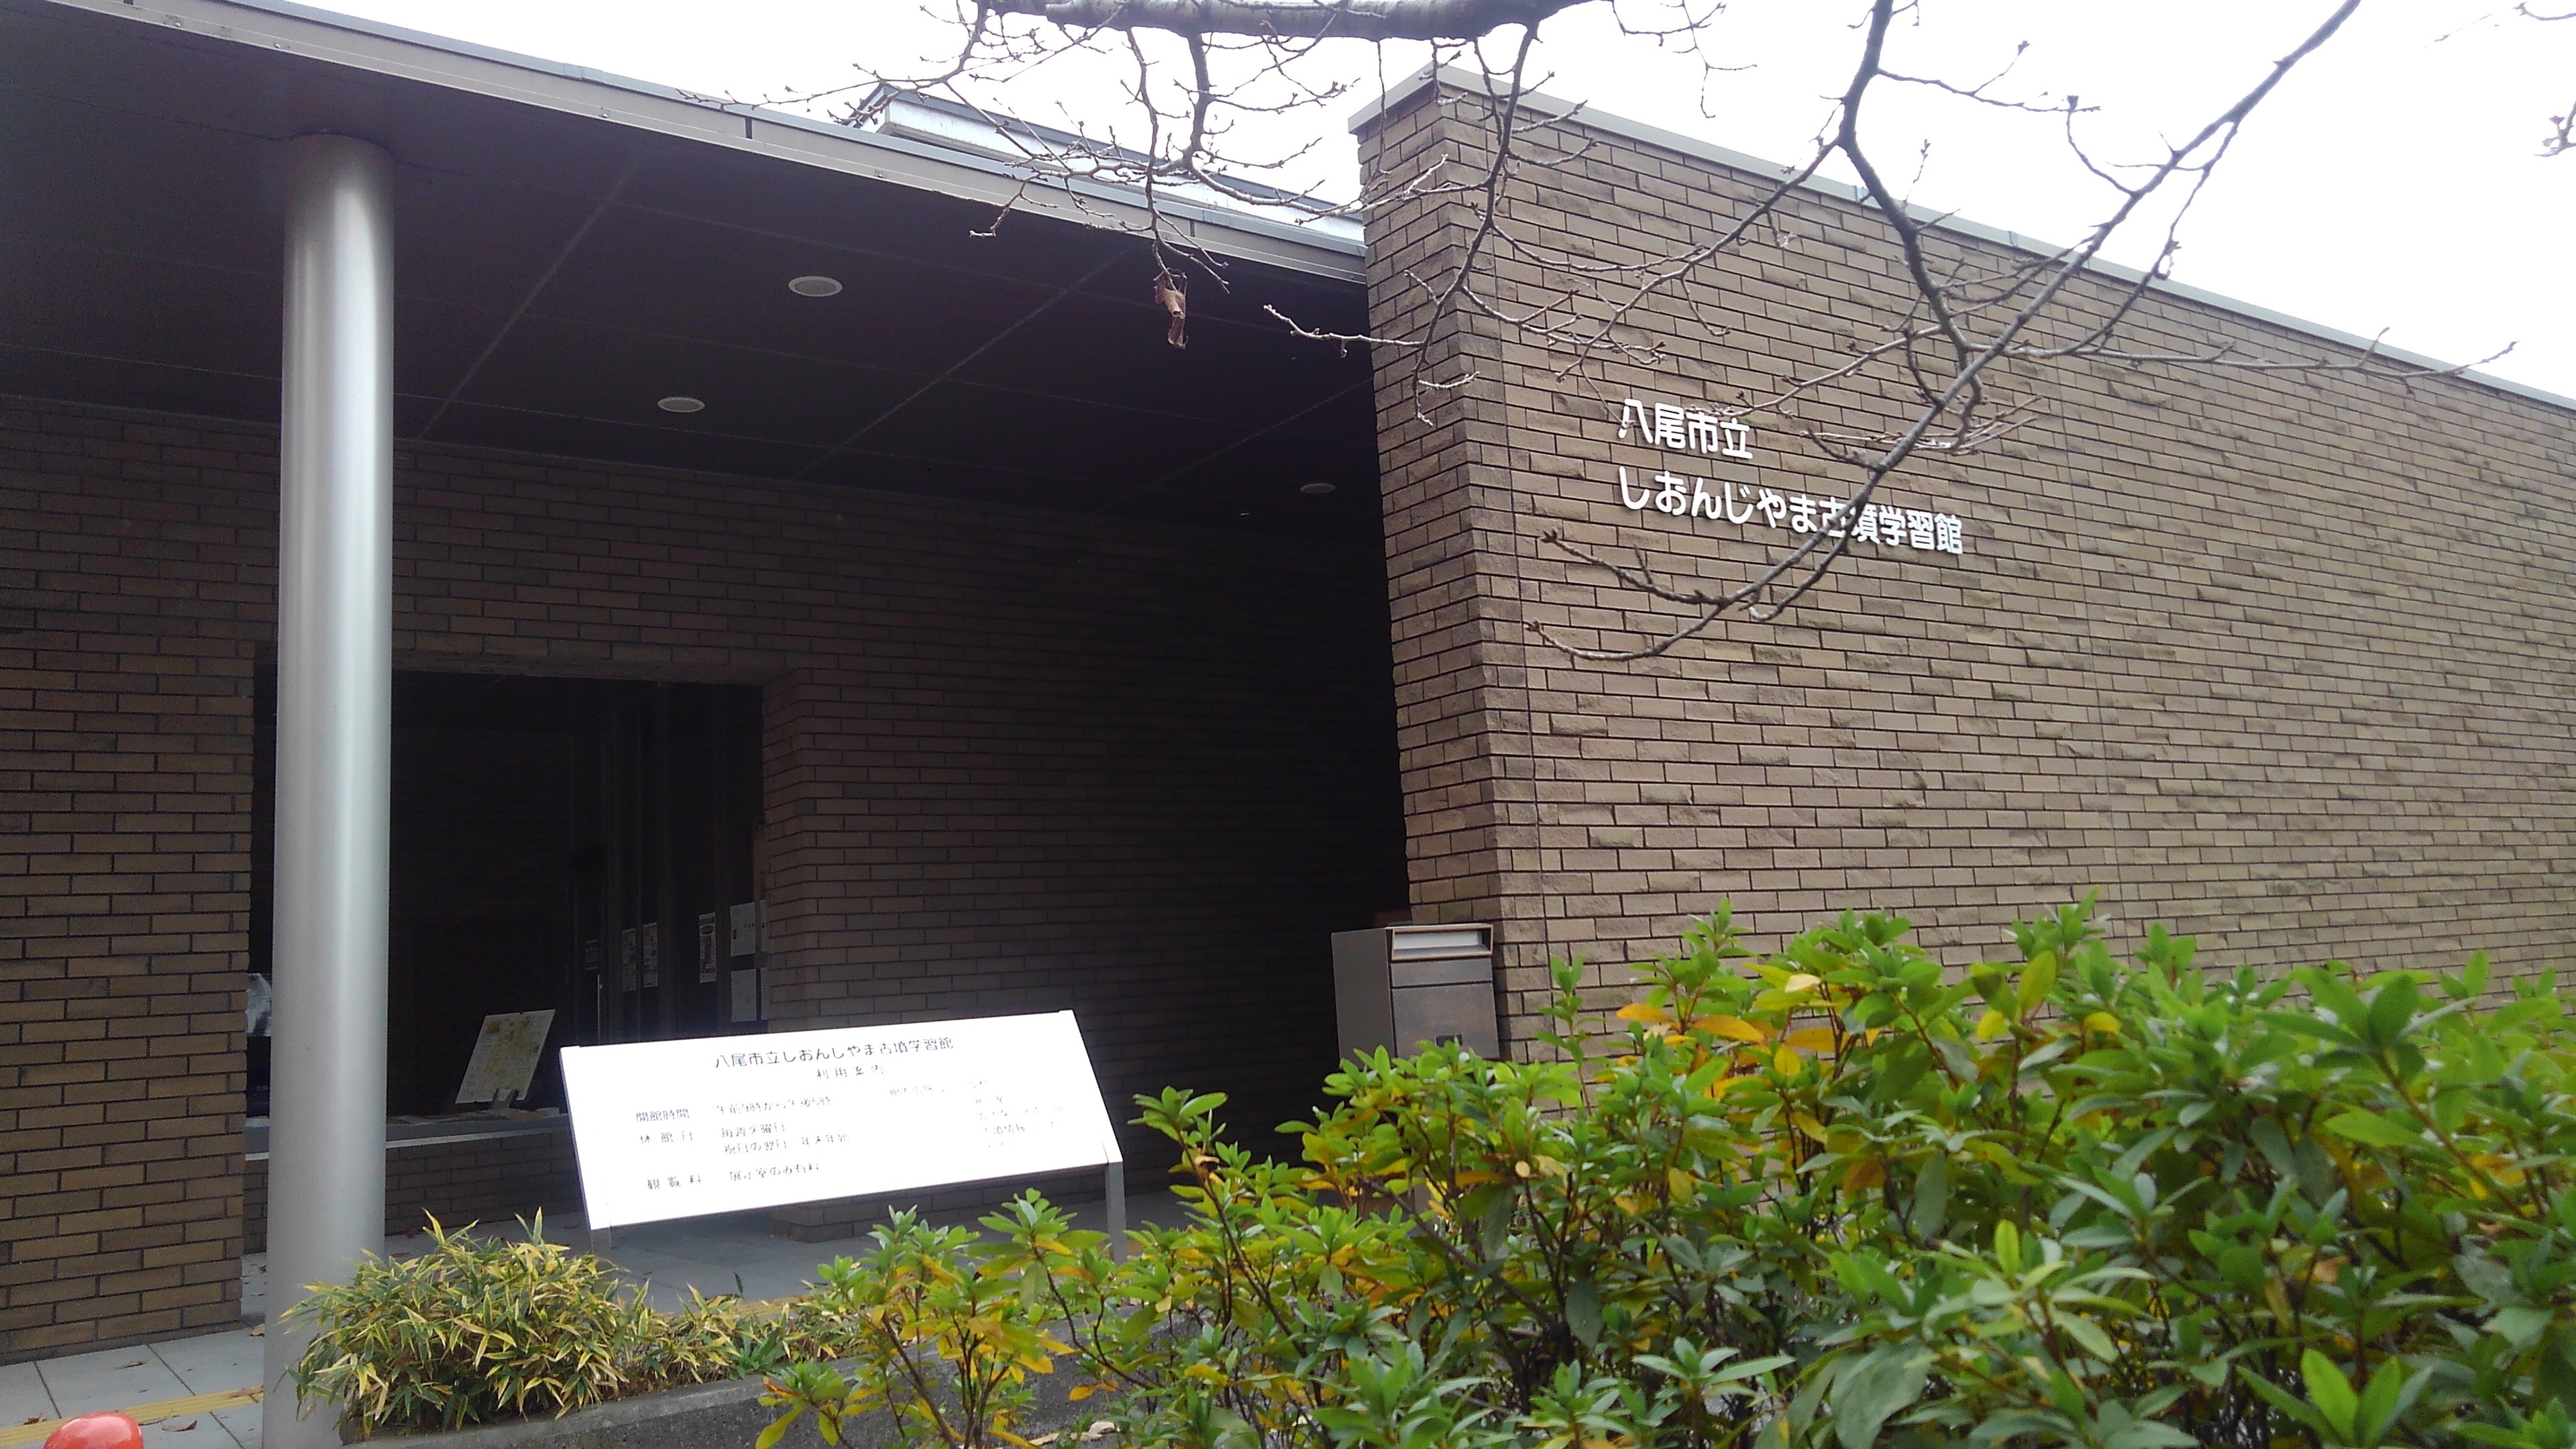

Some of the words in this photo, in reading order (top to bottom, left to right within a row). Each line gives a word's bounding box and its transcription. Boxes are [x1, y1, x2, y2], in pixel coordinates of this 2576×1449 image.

[1617, 398, 1753, 460] 八尾市立
[1618, 466, 1964, 554] しおんじやま古墳学習館
